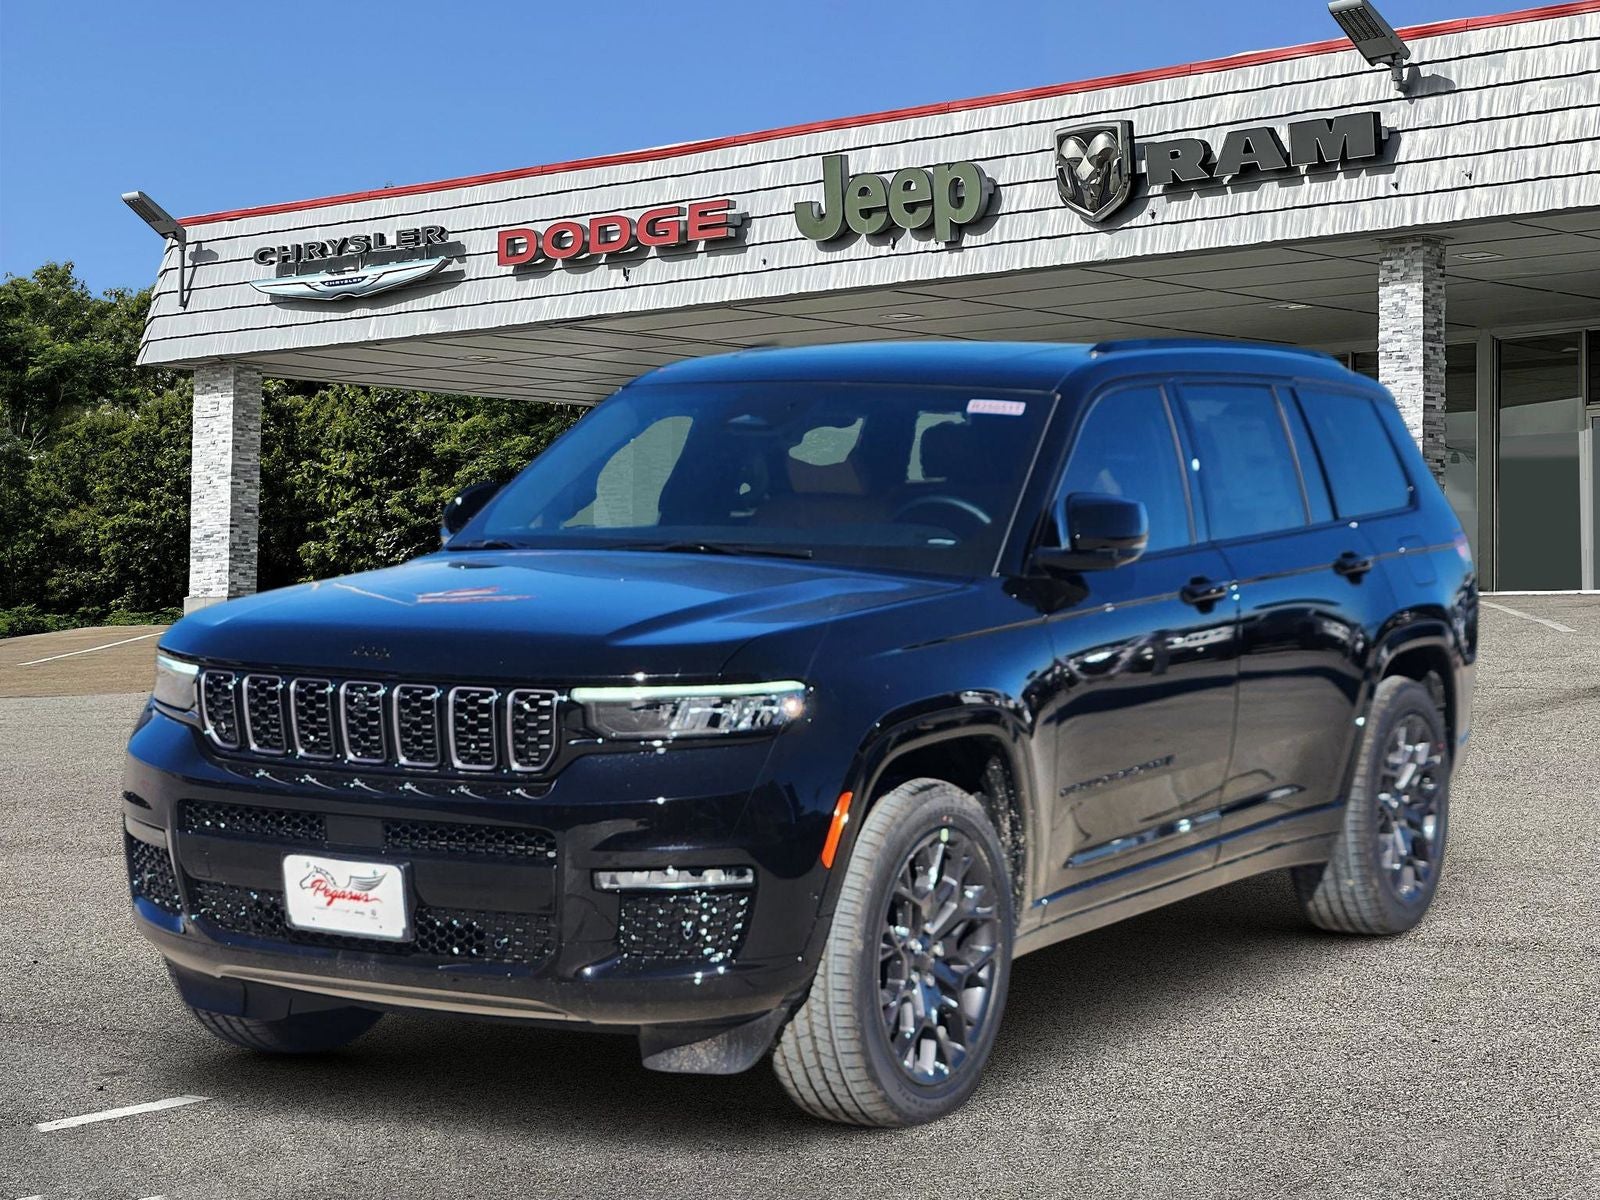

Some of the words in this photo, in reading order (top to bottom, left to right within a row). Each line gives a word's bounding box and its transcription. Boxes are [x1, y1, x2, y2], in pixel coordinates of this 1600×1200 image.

[1146, 111, 1379, 186] RAM
[795, 155, 991, 242] Jeep
[254, 225, 448, 266] CHRYSLER
[498, 200, 736, 266] DODGE
[324, 277, 363, 287] CHRYSLER
[311, 879, 383, 906] Pegasus
